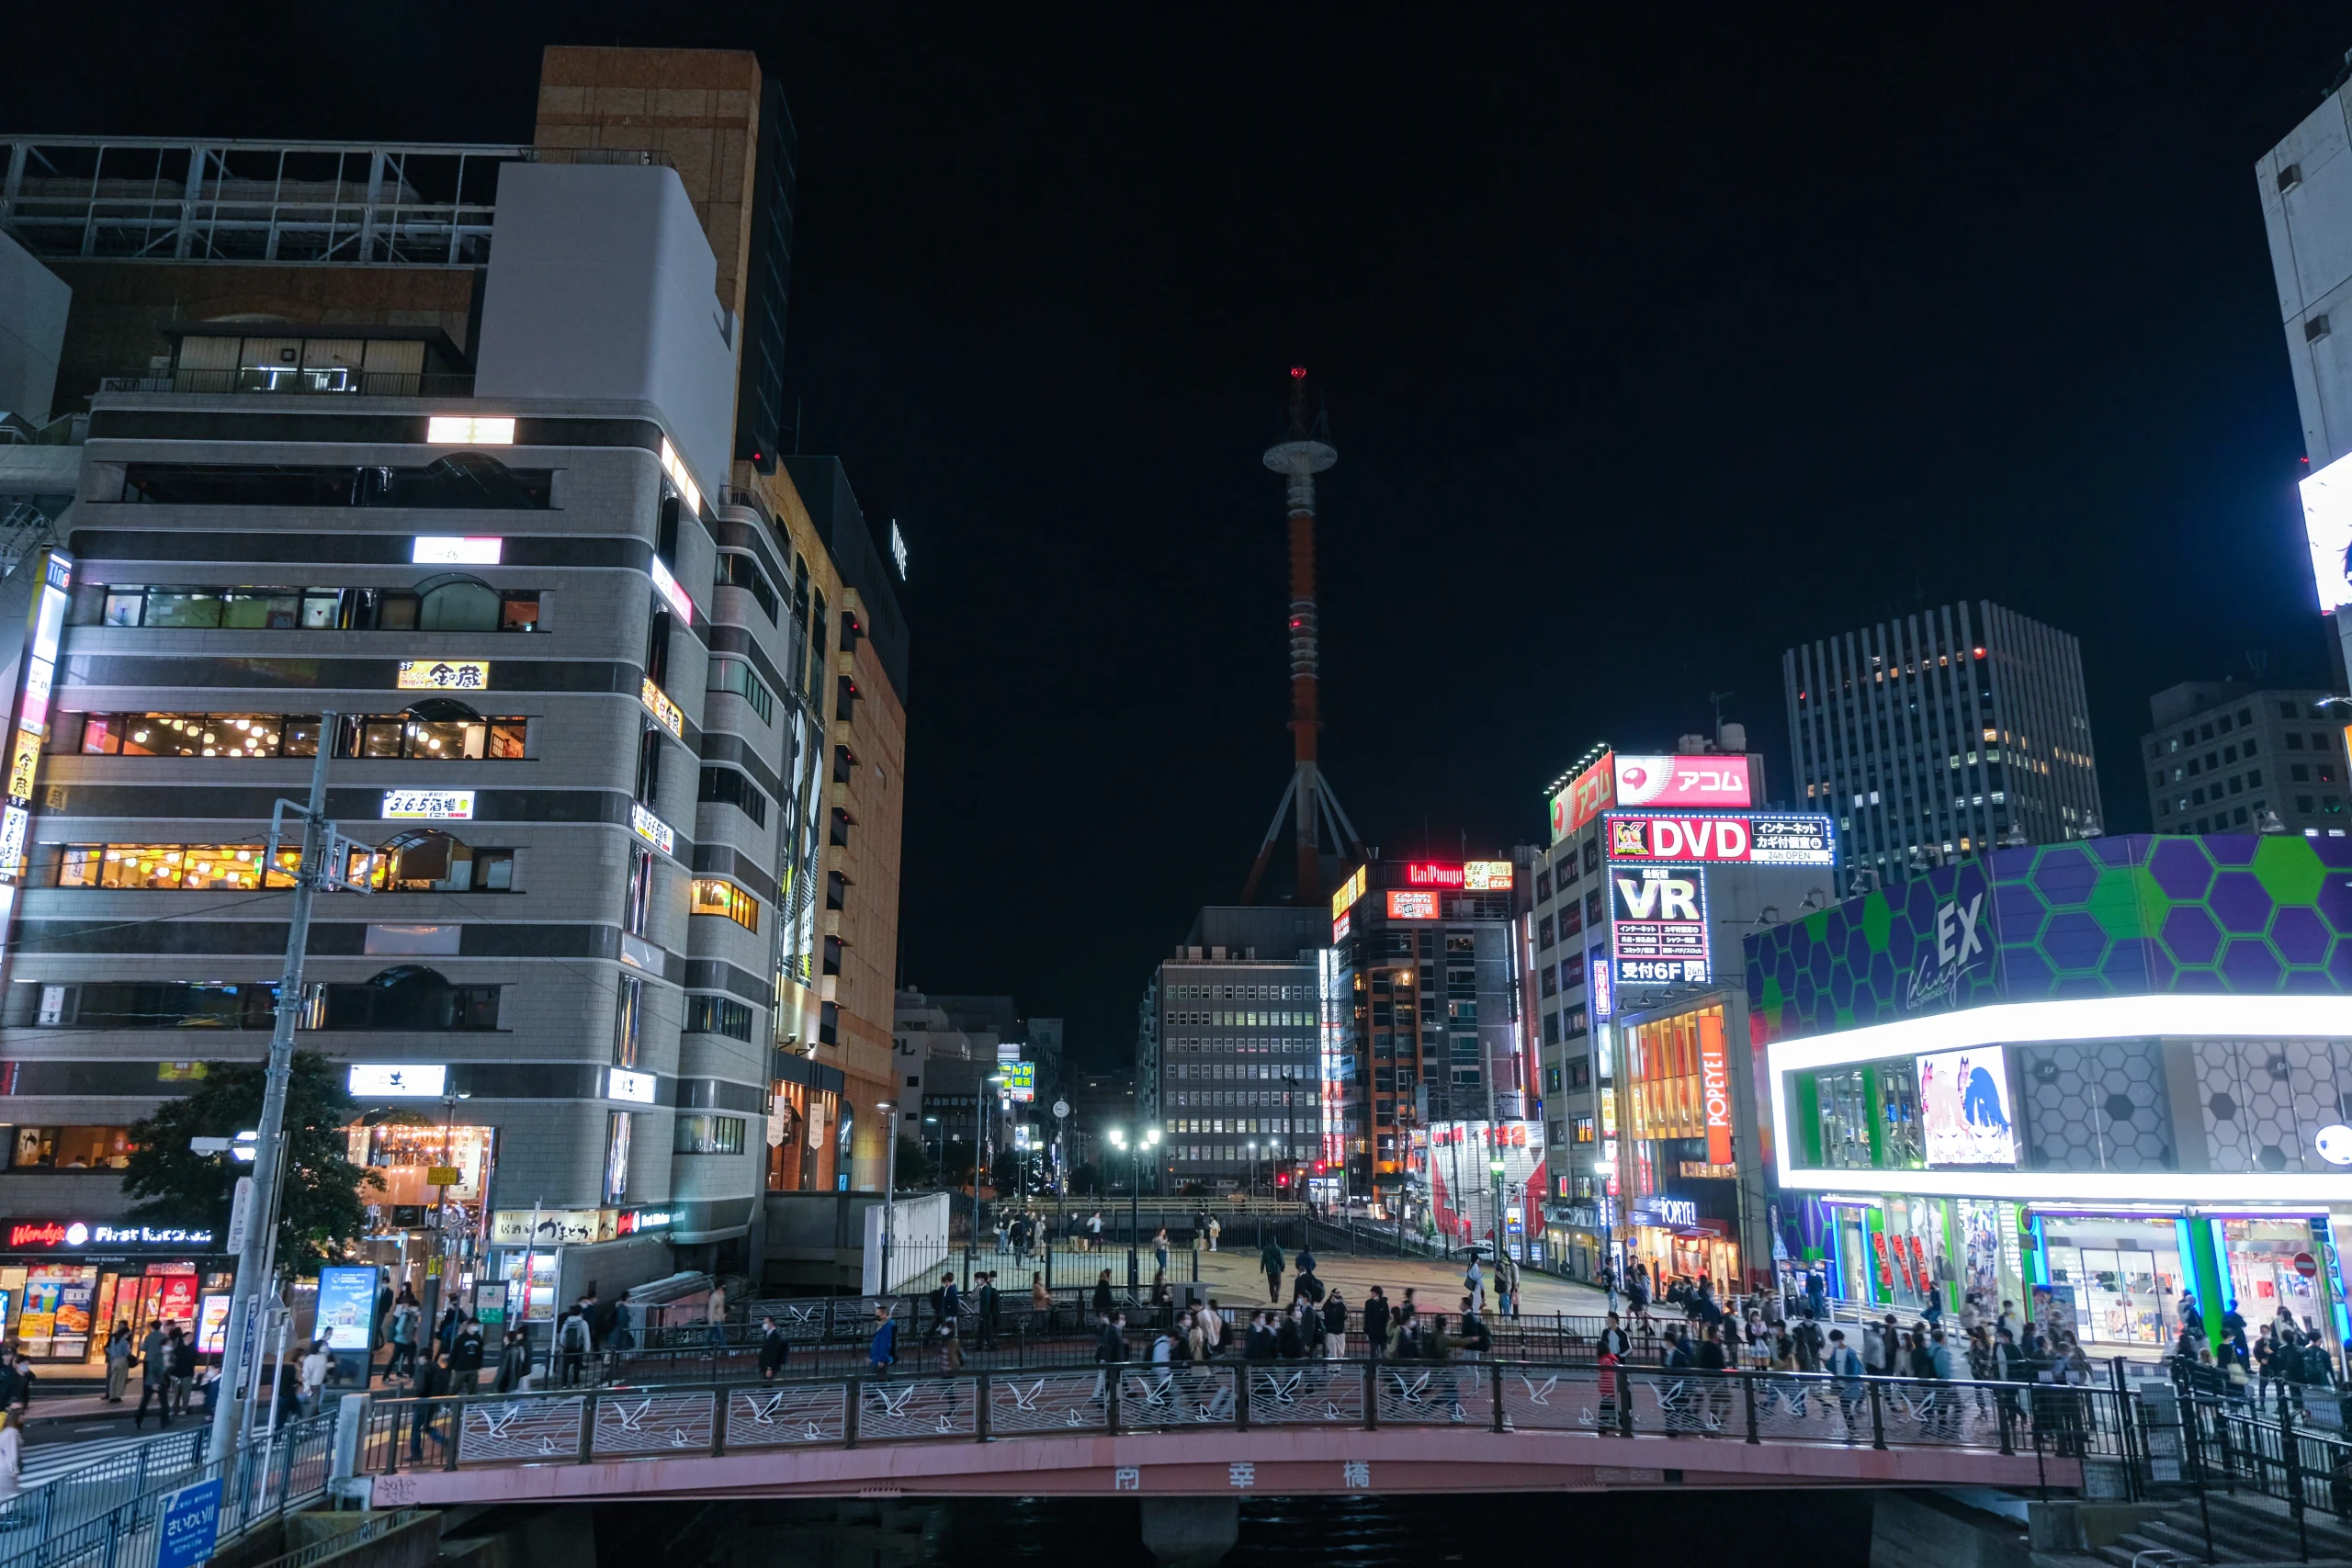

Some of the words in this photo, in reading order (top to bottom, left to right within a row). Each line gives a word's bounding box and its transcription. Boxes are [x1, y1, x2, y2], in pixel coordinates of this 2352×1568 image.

[429, 663, 482, 688] 金の蔵
[1678, 771, 1744, 792] アコム
[1577, 769, 1611, 821] アコム
[1652, 820, 1747, 858] DVD
[1758, 822, 1818, 834] インターネット
[1768, 851, 1783, 860] 24h
[1786, 852, 1811, 861] OPEN
[1617, 878, 1701, 919] VR
[1938, 892, 1983, 967] EX
[1622, 962, 1681, 980] 受付6F
[1703, 1052, 1728, 1126] POPEYE!
[1661, 1200, 1696, 1226] POPEYE!
[12, 1223, 65, 1246] Wendy's
[96, 1227, 139, 1241] First
